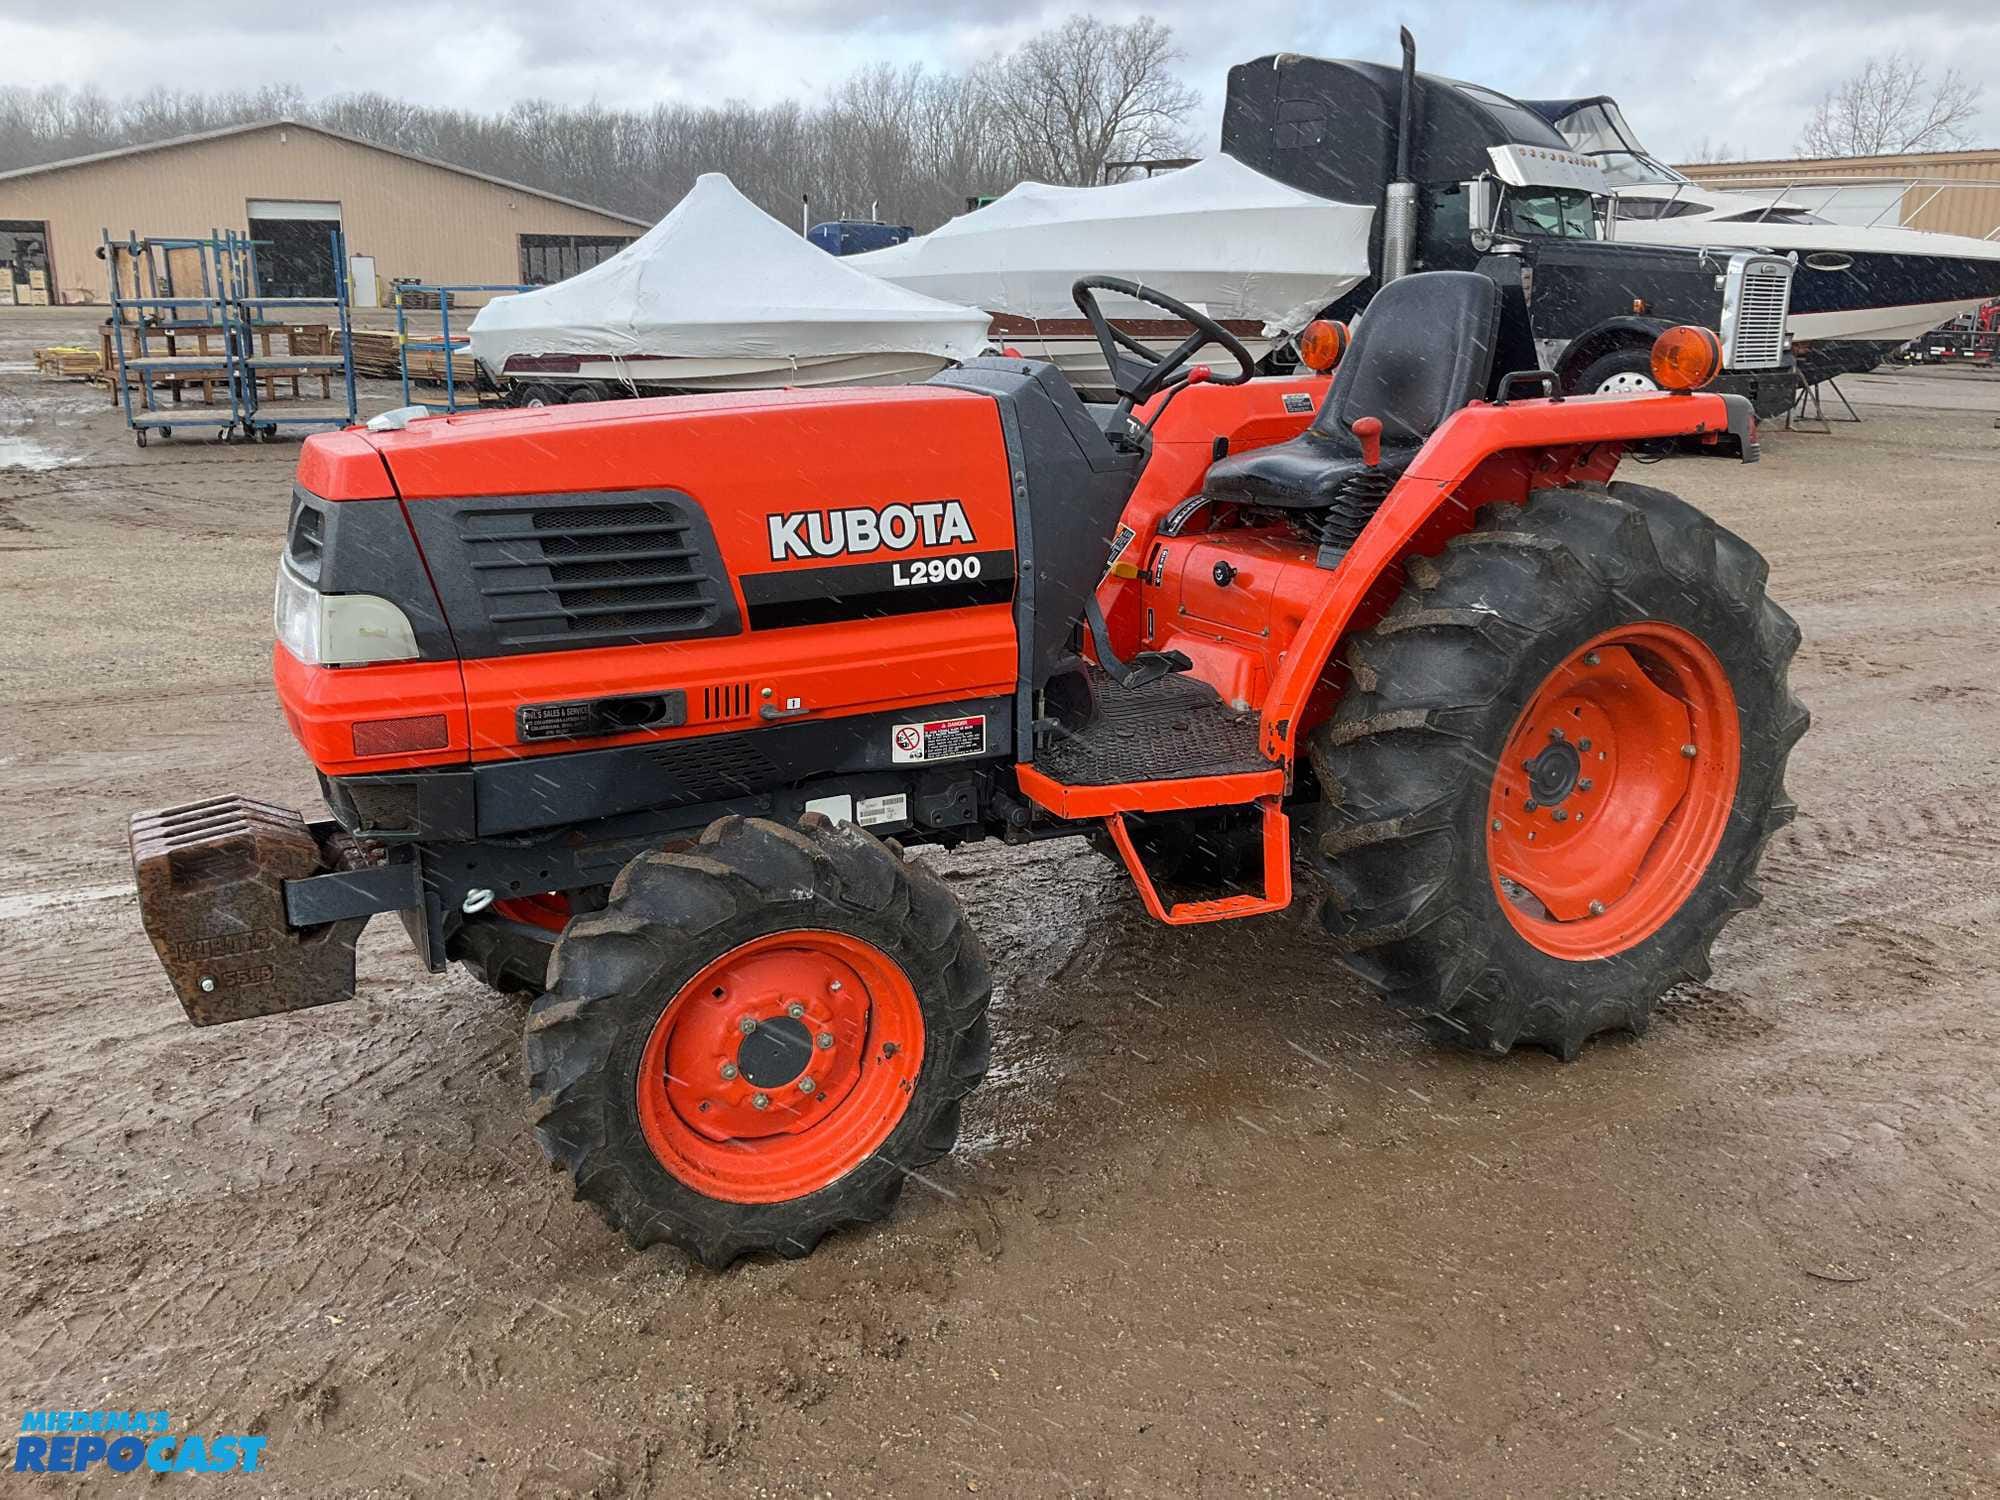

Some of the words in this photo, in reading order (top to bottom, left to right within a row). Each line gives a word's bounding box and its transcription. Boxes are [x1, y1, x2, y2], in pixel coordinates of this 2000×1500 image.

[767, 500, 977, 561] KUBOTA
[893, 556, 981, 587] L2900
[543, 708, 560, 718] SALES
[567, 706, 588, 716] SERVICE
